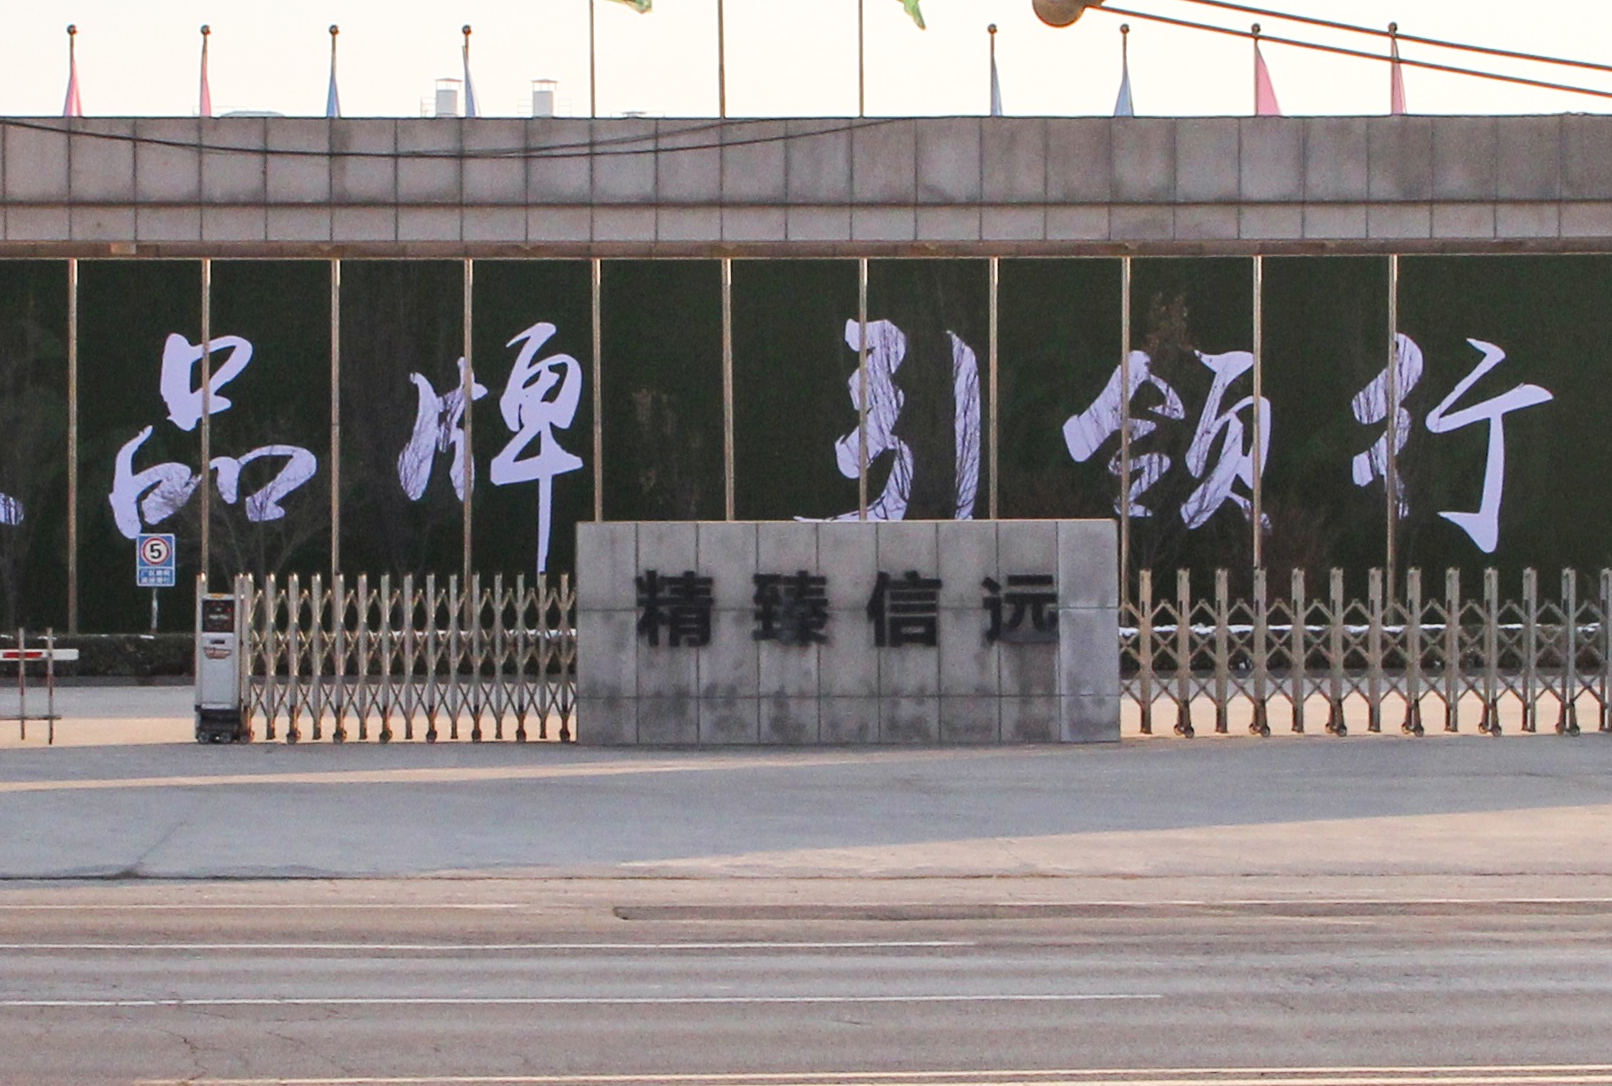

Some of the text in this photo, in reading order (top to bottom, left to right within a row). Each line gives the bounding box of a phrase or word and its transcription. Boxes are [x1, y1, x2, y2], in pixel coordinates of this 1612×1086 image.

[150, 543, 162, 560] 5
[634, 569, 1060, 648] 精臻信远
